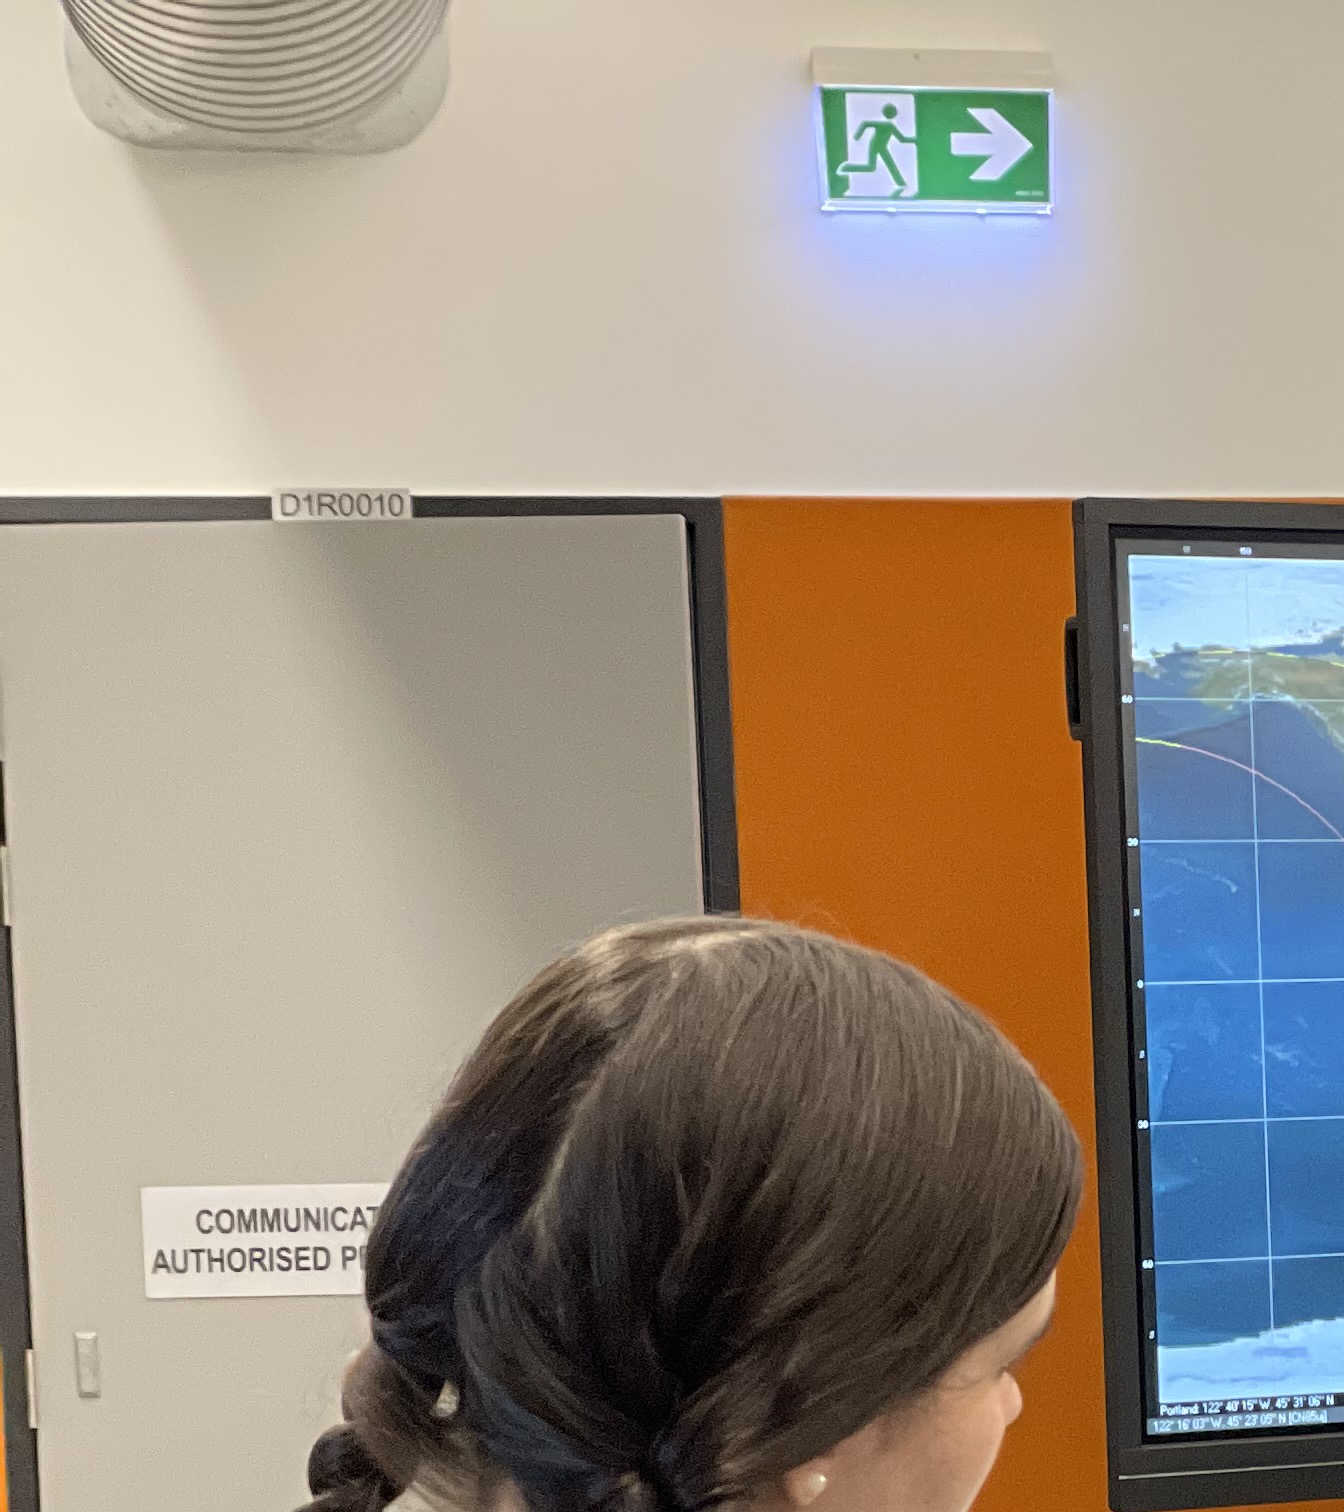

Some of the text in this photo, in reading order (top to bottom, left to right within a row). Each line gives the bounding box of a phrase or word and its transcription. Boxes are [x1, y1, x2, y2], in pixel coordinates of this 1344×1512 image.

[280, 492, 404, 517] D1R0010
[151, 1246, 331, 1275] AUTHORISED
[1326, 1394, 1335, 1406] N
